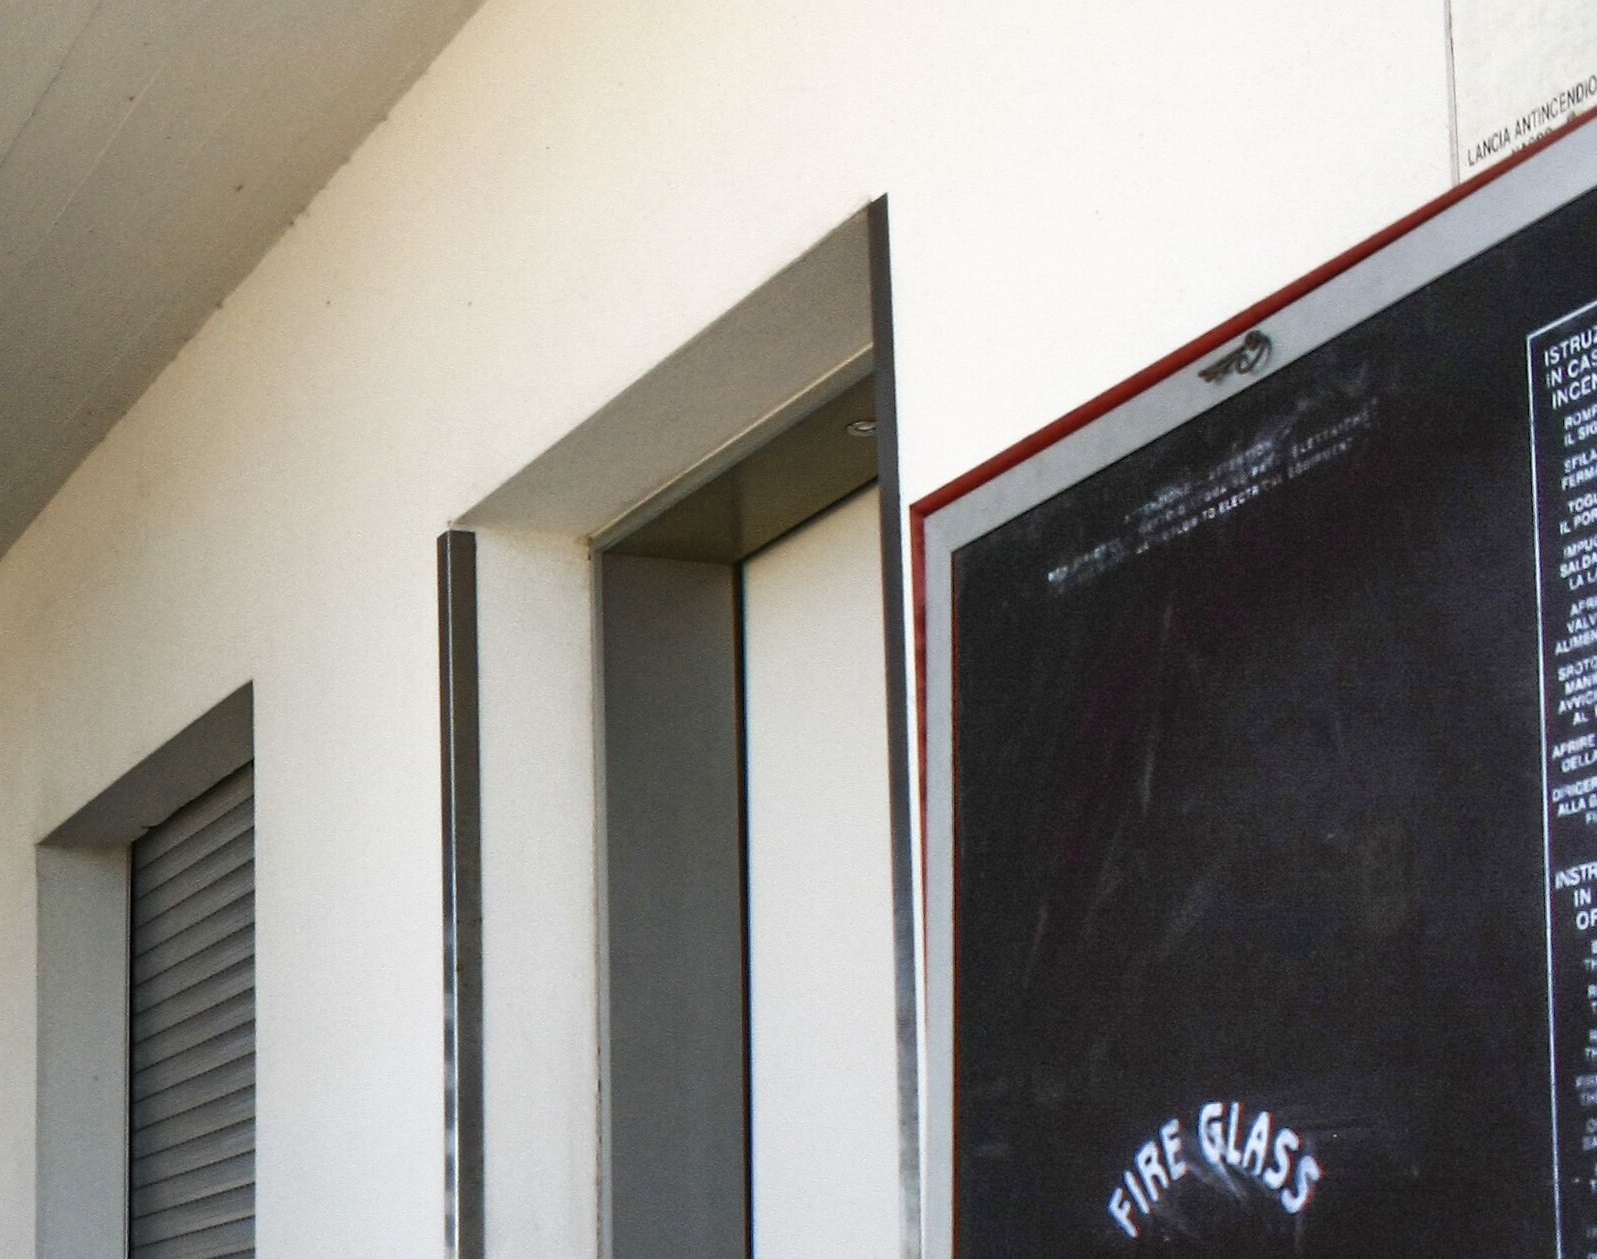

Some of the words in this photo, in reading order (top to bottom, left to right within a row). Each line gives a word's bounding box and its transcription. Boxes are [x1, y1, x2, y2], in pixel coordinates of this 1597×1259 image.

[1467, 128, 1510, 167] LANCIA
[1514, 75, 1597, 138] ANTINCENDIO
[1546, 367, 1562, 389] IN
[1574, 887, 1592, 907] IN
[1107, 1117, 1189, 1239] FIRE
[1197, 1100, 1325, 1215] GLASS
